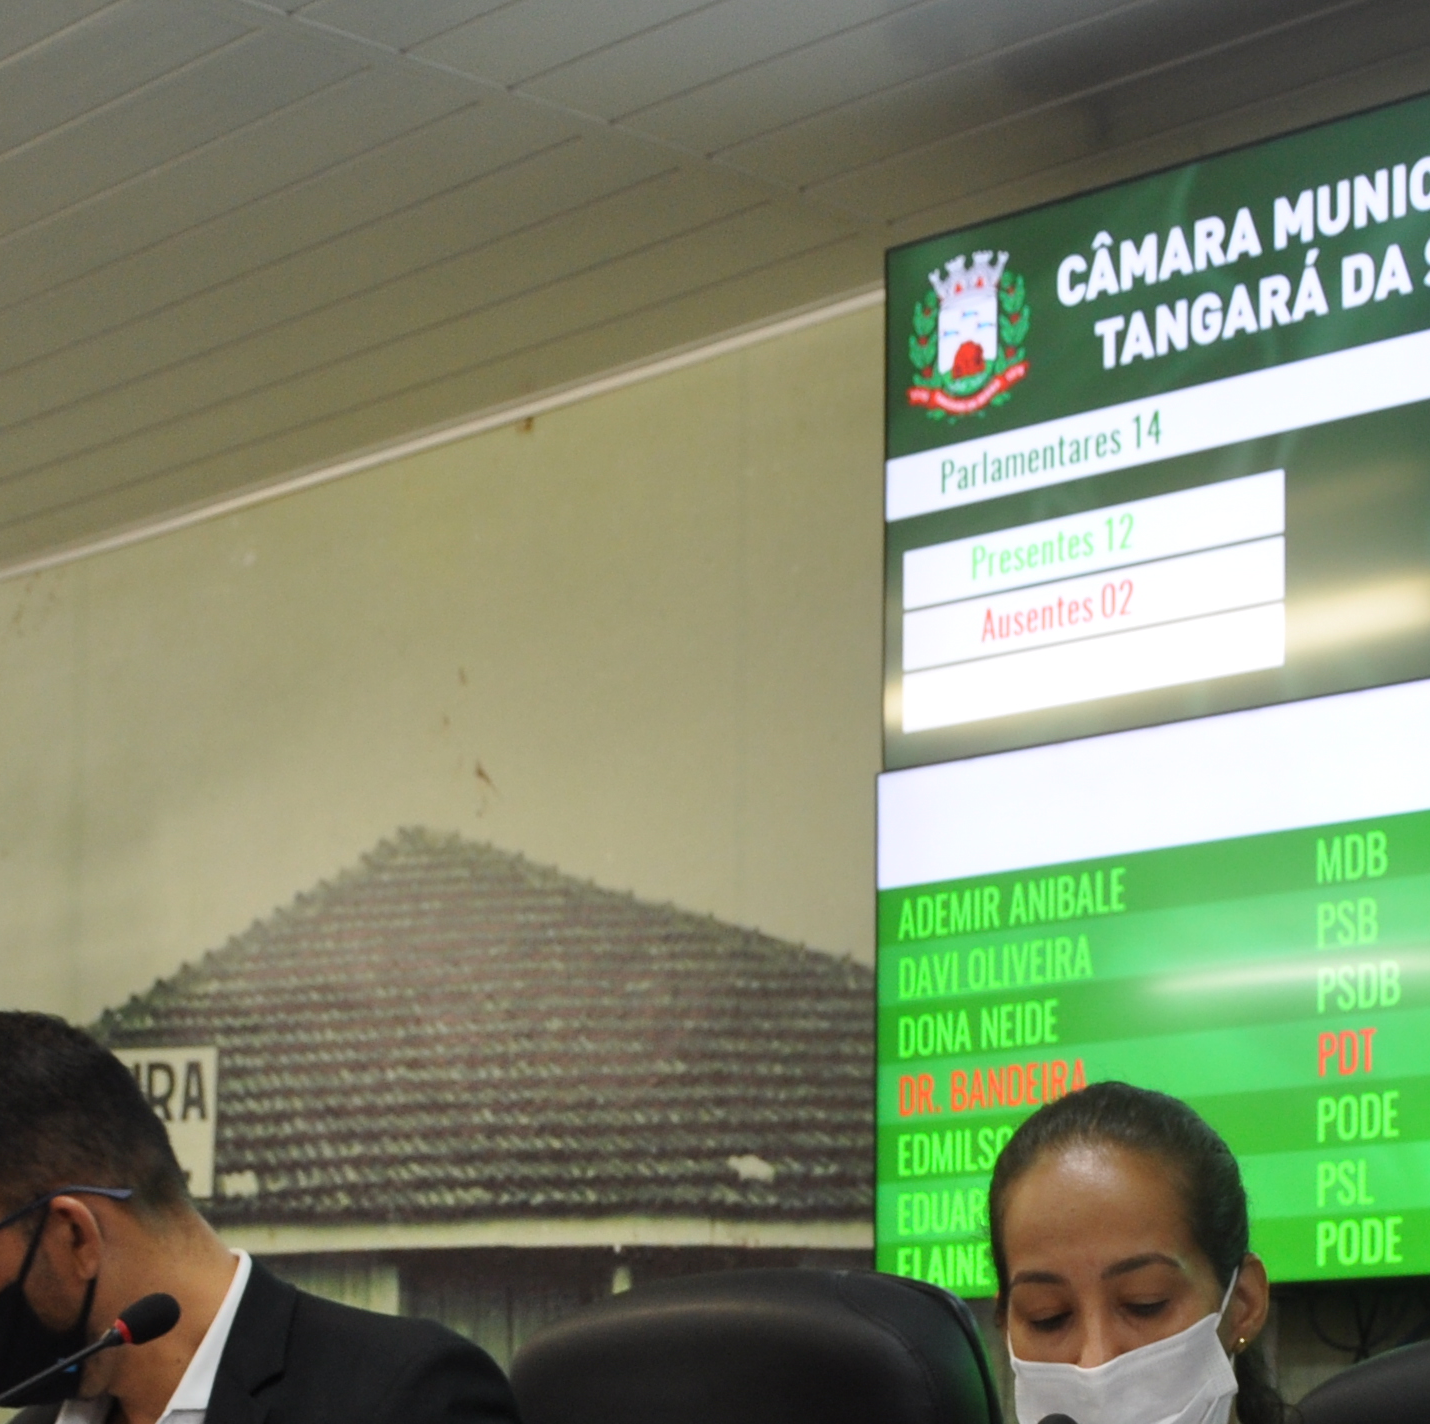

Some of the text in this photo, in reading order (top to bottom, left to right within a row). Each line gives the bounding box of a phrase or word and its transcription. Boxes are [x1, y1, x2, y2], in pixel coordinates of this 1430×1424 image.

[1056, 207, 1261, 307] CÂMARA
[1094, 248, 1327, 371] TANGARÁ
[1340, 241, 1413, 309] DA
[939, 410, 1163, 495] Parlamentares 14
[970, 513, 1135, 582] Presentes 12
[980, 581, 1135, 644] Ausentes 02
[1316, 830, 1388, 883] MDB
[898, 867, 1127, 940] ADEMIR ANIBALE
[1317, 897, 1378, 950] PSB
[898, 934, 1094, 1000] DAVI OLIVEIRA
[1317, 960, 1401, 1014] PSDB
[898, 998, 1059, 1059] DONA NEIDE
[1317, 1027, 1378, 1077] PDT
[899, 1058, 1088, 1117] DR. BANDEIRA
[1317, 1091, 1401, 1143] PODE
[1317, 1160, 1375, 1208] PSL
[1317, 1215, 1404, 1268] PODE
